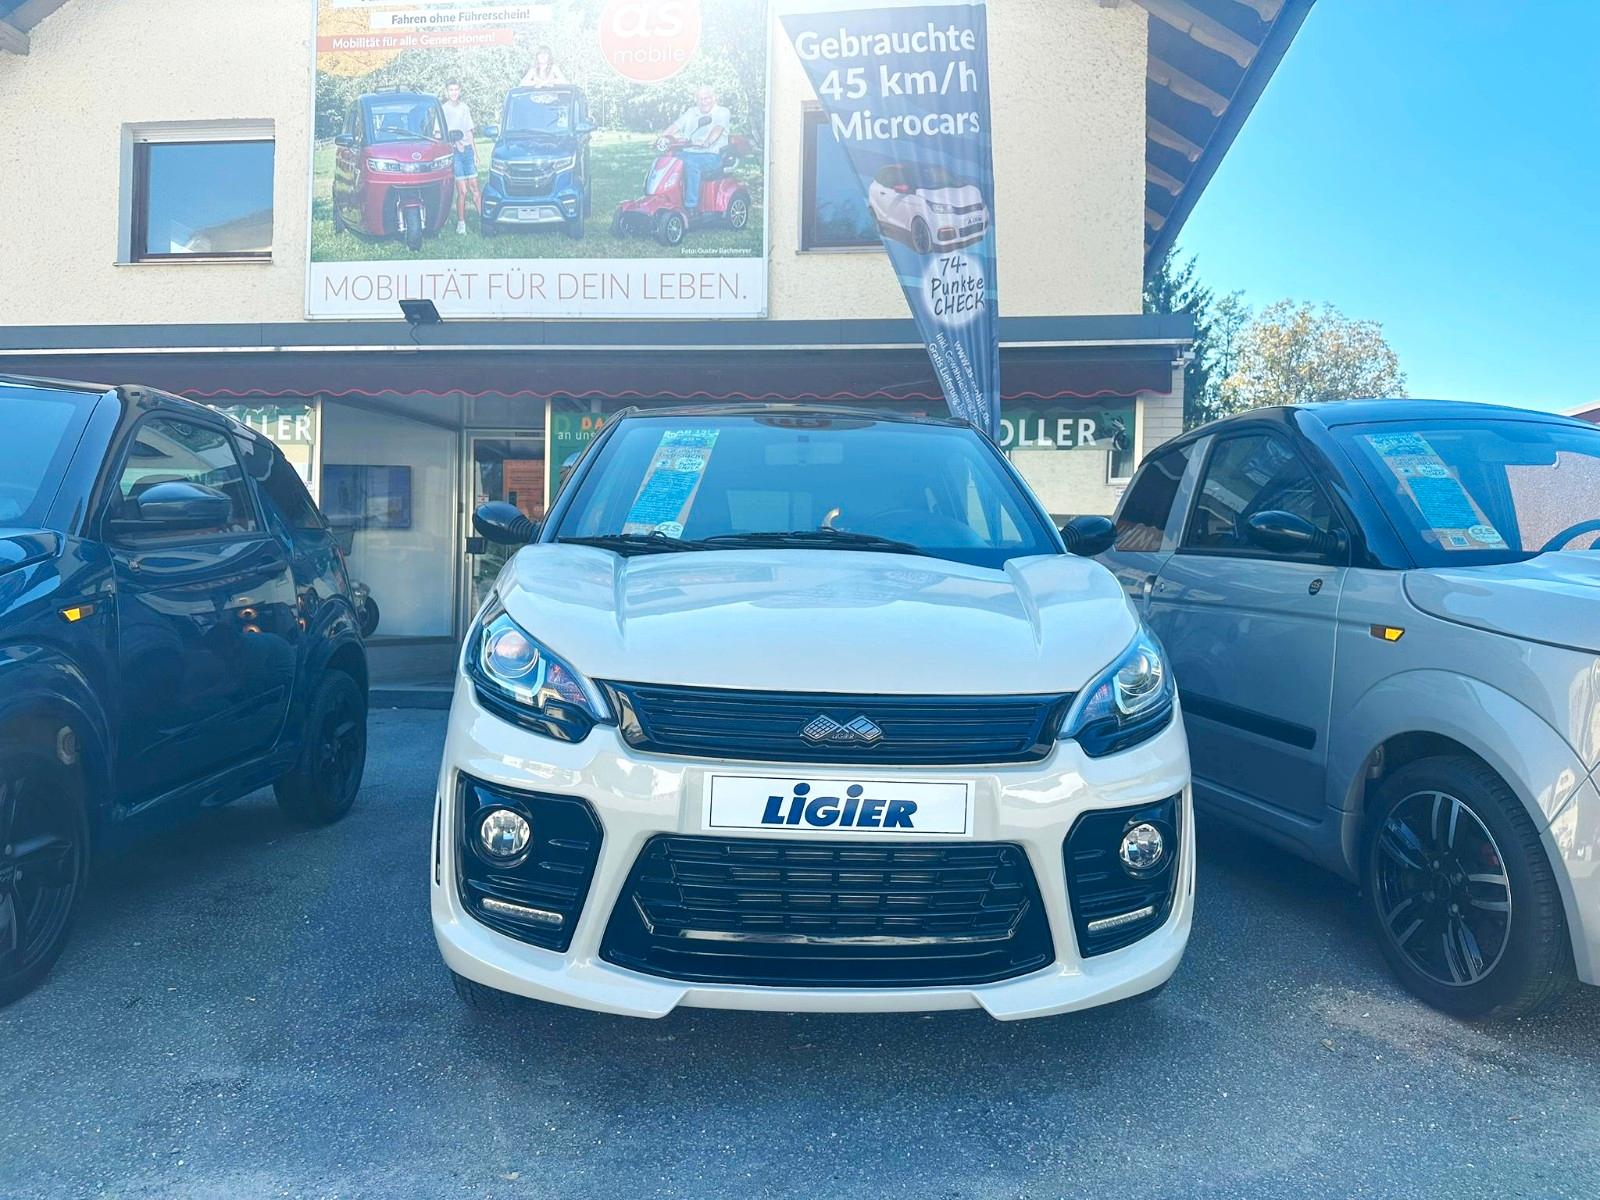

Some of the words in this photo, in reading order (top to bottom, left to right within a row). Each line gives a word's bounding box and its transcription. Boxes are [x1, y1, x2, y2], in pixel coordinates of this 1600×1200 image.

[391, 14, 427, 25] Fahren
[429, 12, 456, 23] ohne
[458, 9, 530, 22] Führerschein!
[332, 36, 380, 49] Mobilität
[382, 34, 399, 47] für
[400, 34, 418, 46] alle
[420, 31, 495, 46] Generationen!
[615, 40, 685, 64] mobile
[795, 22, 976, 61] Gebrauchte
[819, 67, 868, 101] 45
[879, 61, 978, 98] km/h
[830, 109, 980, 143] Microcars
[939, 255, 968, 277] 74-
[325, 267, 479, 301] MOBILITÄT
[488, 266, 547, 300] FÜR
[558, 272, 630, 300] DEIN
[643, 272, 748, 300] LEBEN.
[931, 275, 985, 299] Punkte
[934, 291, 985, 316] CHECK
[928, 342, 944, 368] Gratis
[939, 366, 961, 406] Lieferung
[557, 431, 572, 441] an
